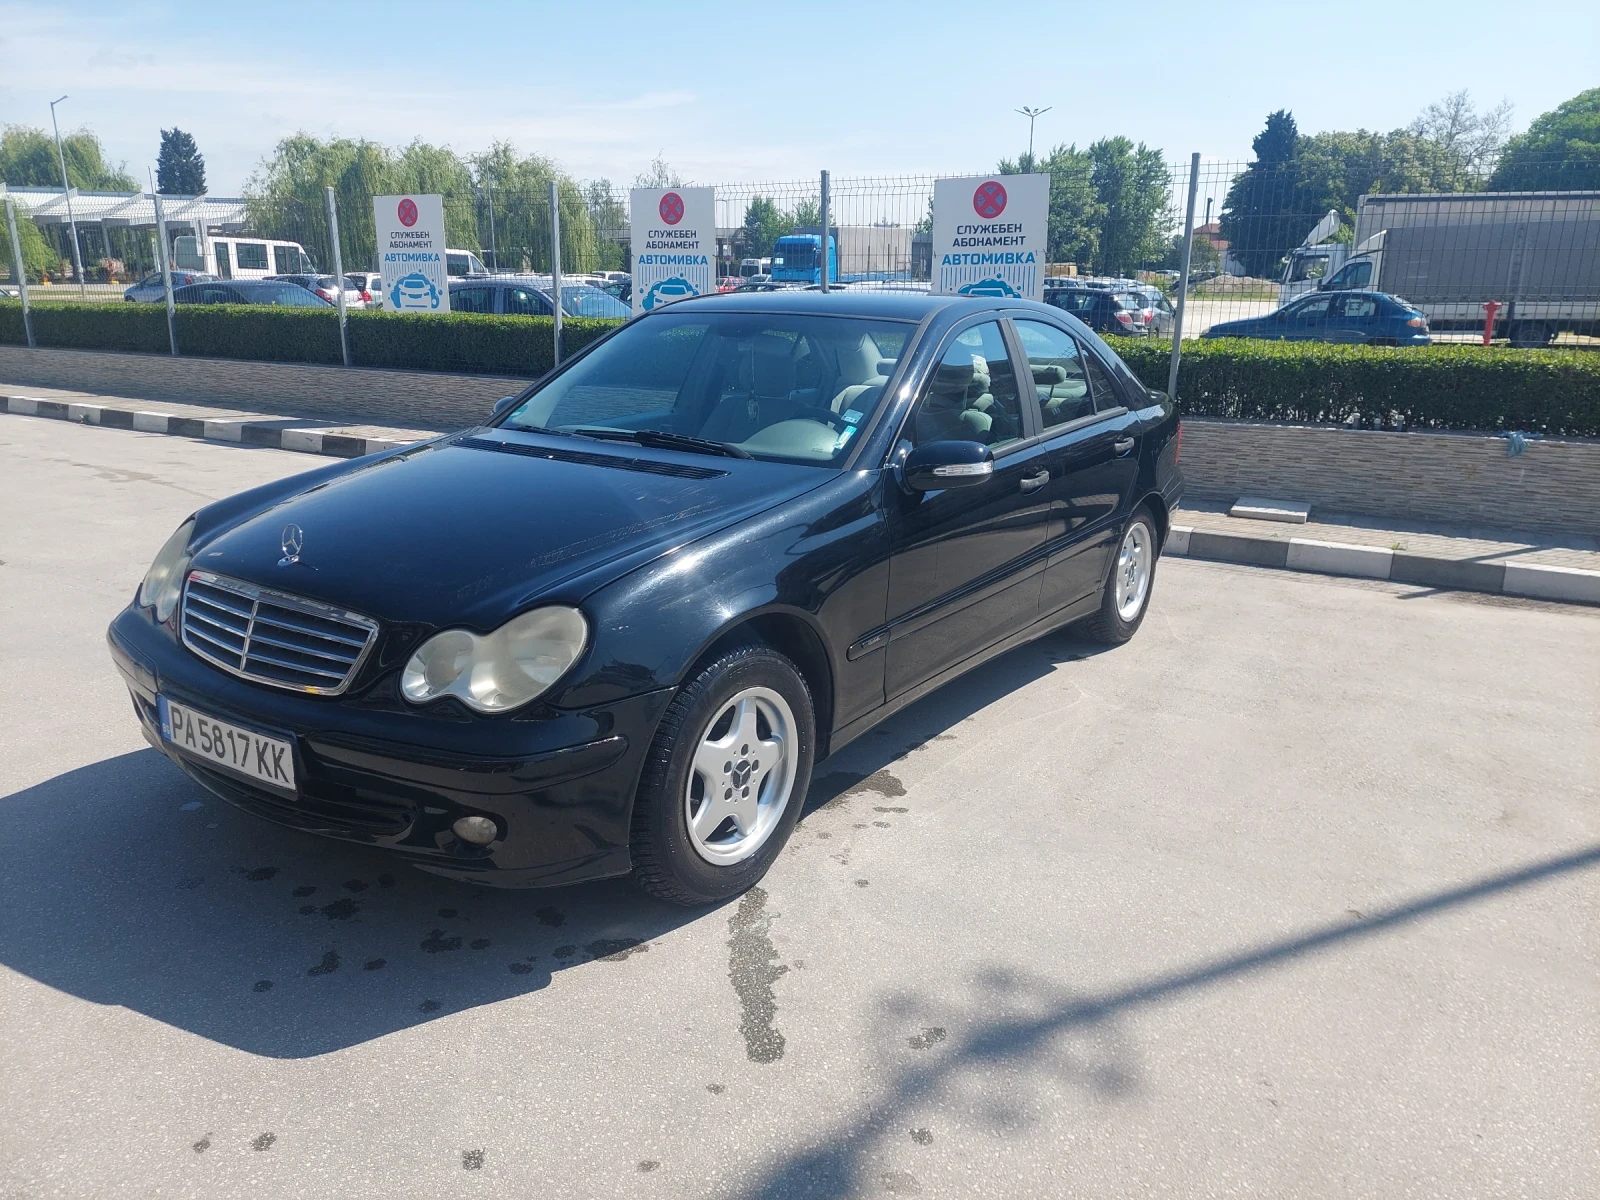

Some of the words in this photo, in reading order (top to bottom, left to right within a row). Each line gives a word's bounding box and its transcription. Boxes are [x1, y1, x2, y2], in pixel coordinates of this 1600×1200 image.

[956, 223, 1022, 235] СЛУЖЕБЕН
[391, 231, 430, 239] СЛУЖЕБЕН
[648, 230, 697, 239] СЛУЖЕБЕН
[389, 240, 433, 249] АБОНАМЕНТ
[645, 241, 700, 249] АБОНАМЕНТ
[952, 235, 1026, 247] АБОНАМЕНТ
[384, 253, 441, 262] АВТОМИВКА
[638, 254, 709, 265] АВТОМИВКА
[941, 252, 1036, 265] АВТОМИВКА
